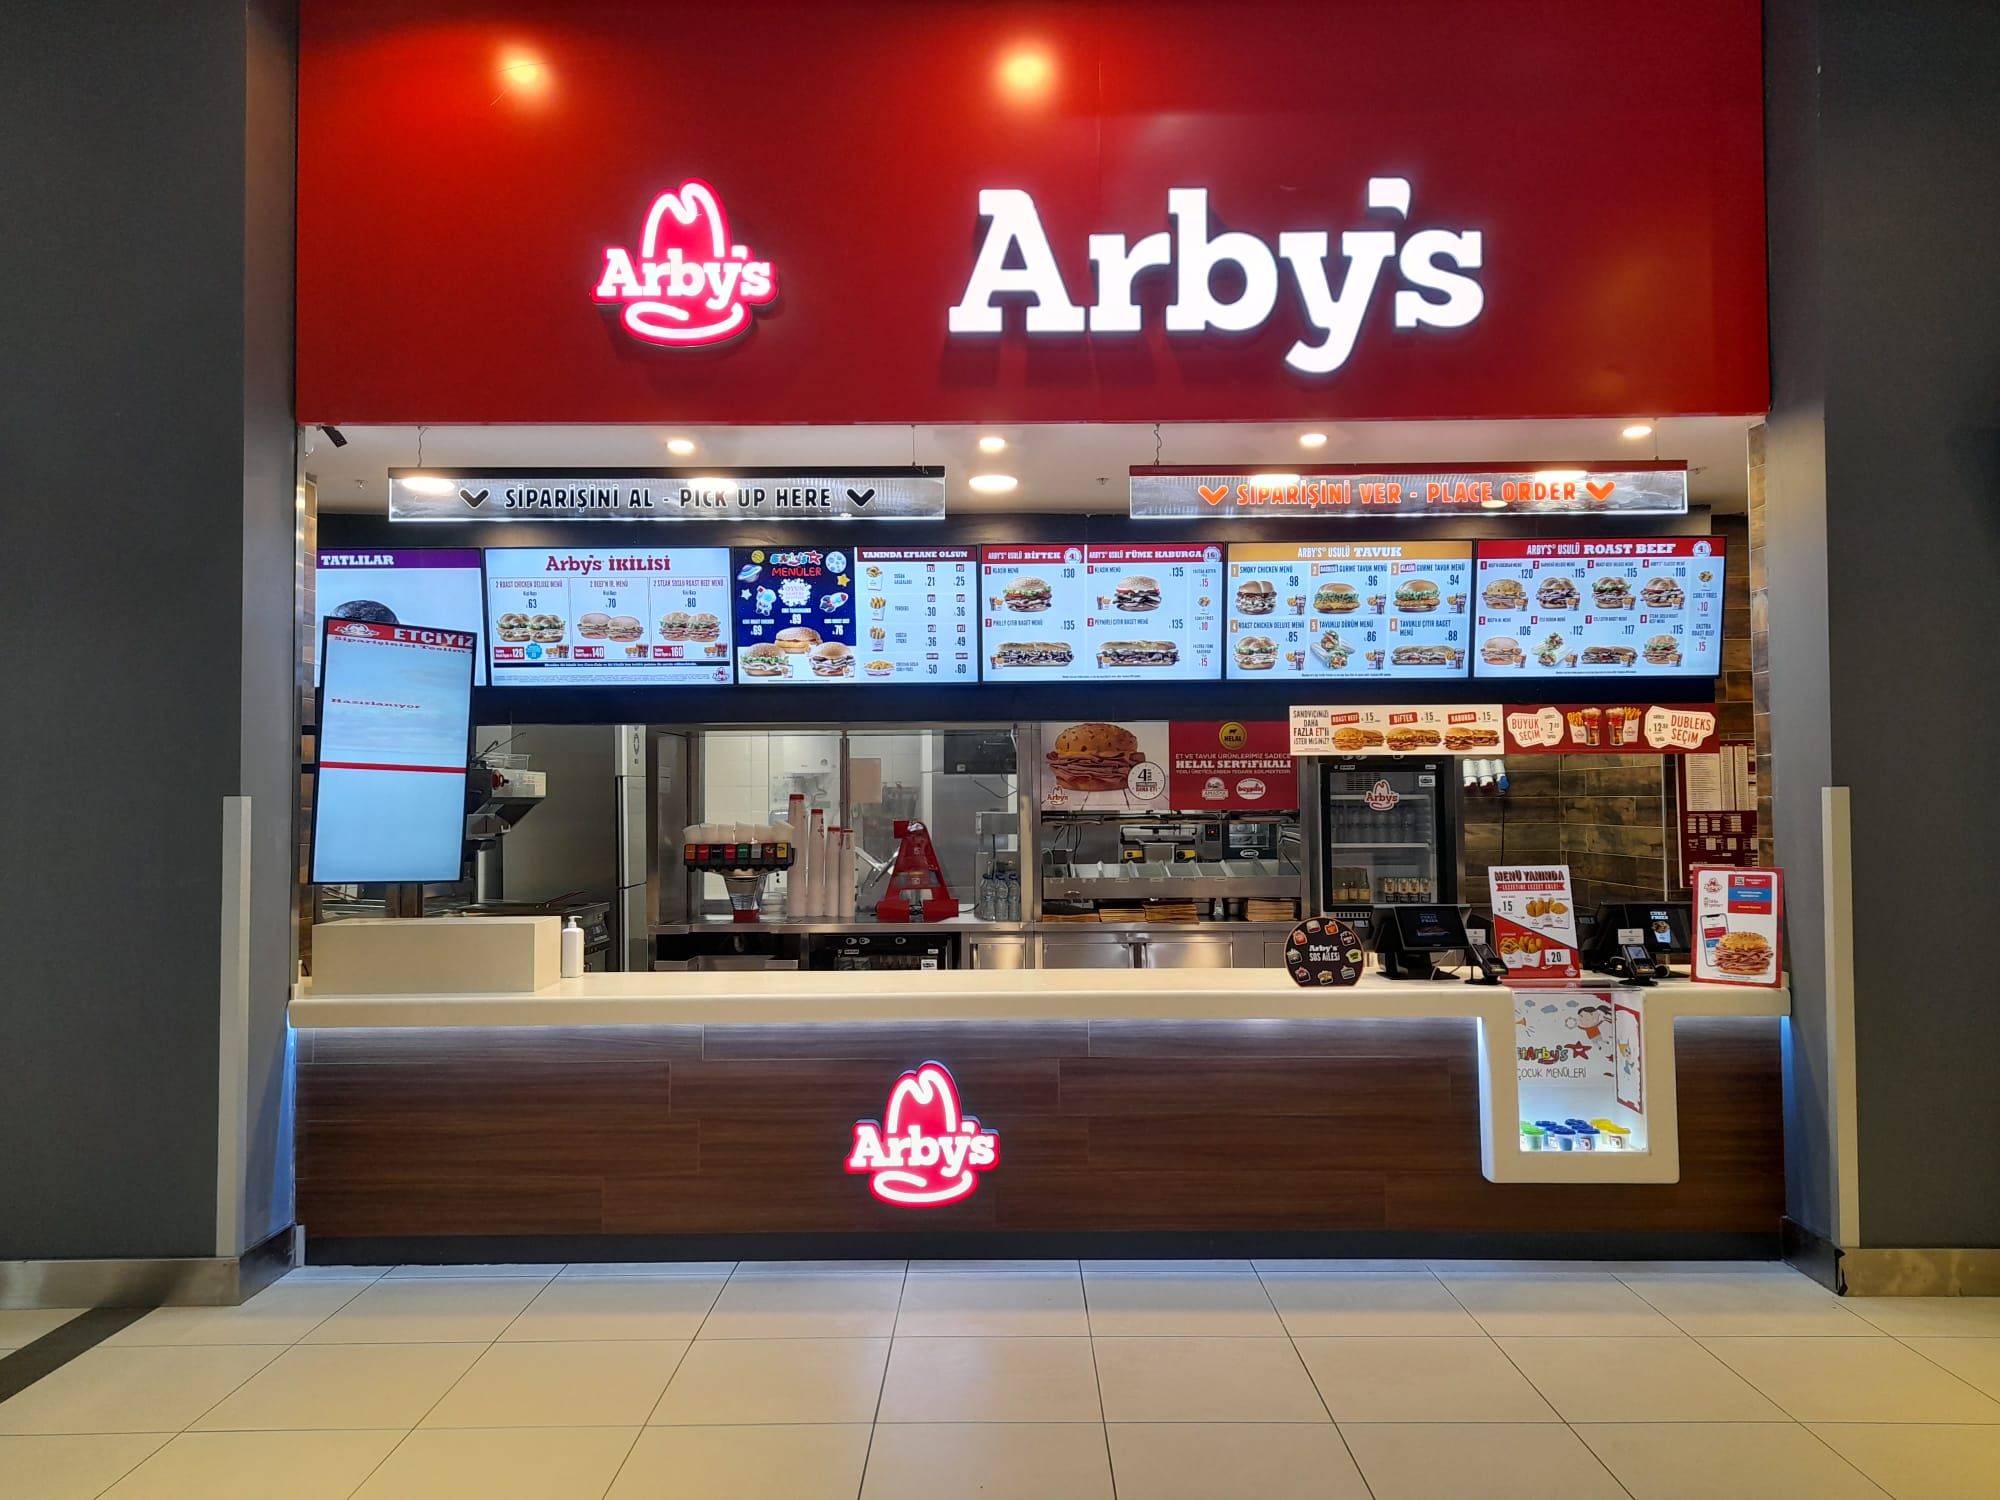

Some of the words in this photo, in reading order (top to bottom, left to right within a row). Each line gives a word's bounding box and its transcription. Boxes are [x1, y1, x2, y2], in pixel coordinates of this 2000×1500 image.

[597, 245, 771, 310] Arby's
[949, 178, 1484, 373] Arby's
[504, 484, 620, 512] SİPARİŞİNİ
[627, 488, 654, 508] AL
[679, 487, 728, 508] PICK
[737, 487, 766, 508] UP
[776, 487, 832, 508] HERE
[1236, 478, 1351, 508] SİPARİŞİNİ
[1359, 483, 1400, 503] VER
[1426, 481, 1493, 503] PLACE
[1502, 480, 1576, 501] ORDER
[1125, 549, 1153, 558] FÜME
[1155, 550, 1202, 558] KABURGA
[1354, 547, 1401, 557] TAVUK
[1584, 544, 1632, 555] ROAST
[1636, 543, 1676, 554] BEEF
[321, 555, 394, 566] TATLILAR
[1024, 551, 1061, 559] BİFTEK
[545, 555, 602, 575] Arby's
[609, 555, 671, 572] İKİLİSİ
[1374, 564, 1387, 572] MENÜ
[1451, 563, 1466, 571] MENÜ
[772, 566, 822, 576] MENÜLER
[1522, 569, 1533, 578] 120
[1575, 568, 1586, 578] 115
[1627, 568, 1638, 578] 115
[1290, 576, 1298, 586] 98
[1368, 576, 1378, 586] 96
[1450, 574, 1459, 586] 94
[1360, 620, 1374, 628] MENÜ
[1448, 630, 1458, 641] 88
[1520, 626, 1531, 636] 106
[1573, 626, 1584, 636] 112
[1625, 625, 1634, 634] 117
[1673, 625, 1684, 634] 115
[1288, 632, 1298, 642] 85
[1367, 631, 1376, 642] 86
[1671, 714, 1712, 732] DUBLEKS
[1294, 728, 1314, 736] FAZLA
[1672, 728, 1698, 744] SEÇİM
[1176, 760, 1214, 768] HELAL
[1217, 760, 1292, 768] SERTİFİKALI
[1138, 768, 1147, 782] 4
[1366, 792, 1398, 804] Arby's
[1494, 870, 1522, 882] MENÜ
[1522, 870, 1564, 881] YANINDA
[1502, 900, 1512, 912] 15
[1309, 945, 1338, 954] Arby's
[1309, 952, 1320, 961] SOS
[1551, 952, 1562, 962] 20
[1546, 1066, 1586, 1078] MENÜLERİ
[850, 1122, 995, 1178] Arby's
